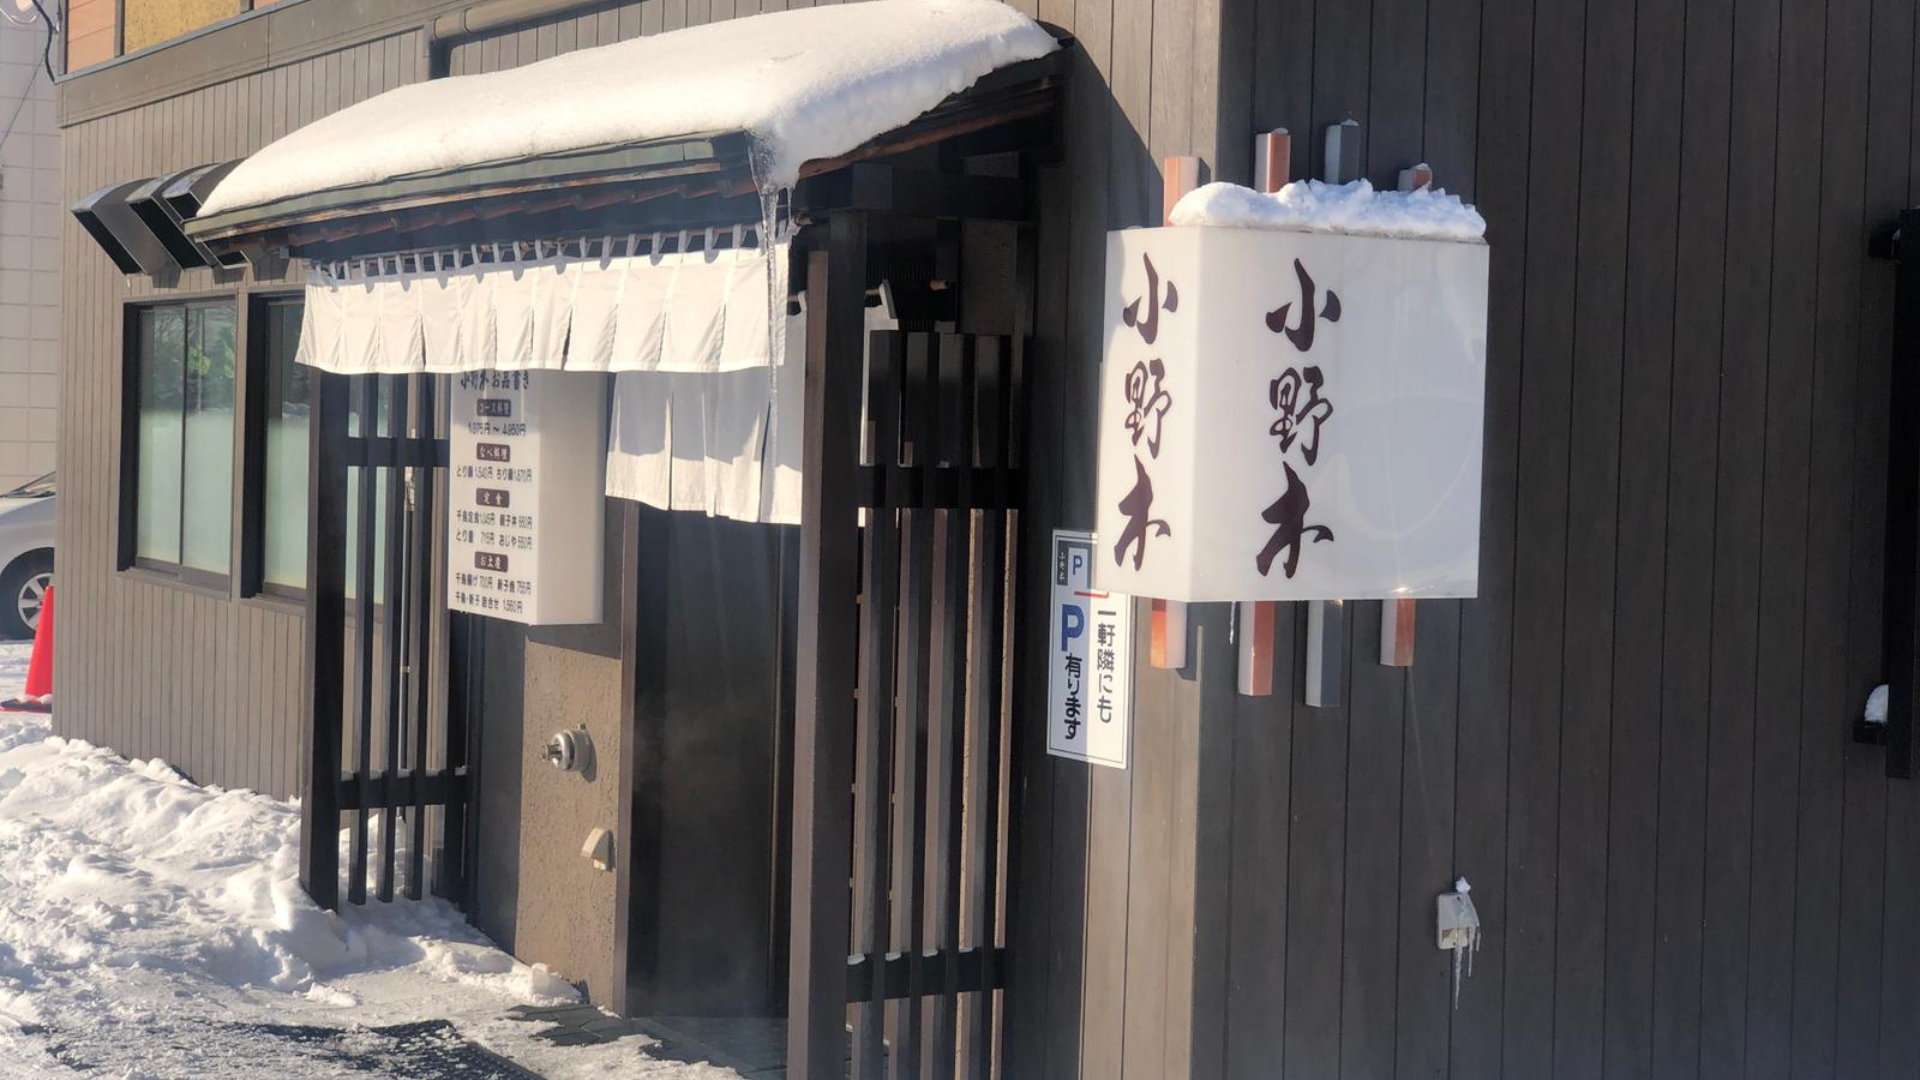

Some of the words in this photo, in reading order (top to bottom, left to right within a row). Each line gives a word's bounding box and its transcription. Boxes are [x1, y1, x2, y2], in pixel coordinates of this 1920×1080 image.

[1114, 252, 1178, 571] 小野木
[1255, 258, 1342, 579] 小野木
[479, 446, 508, 460] なべ料理
[480, 555, 501, 570] お土産
[1073, 554, 1083, 576] P
[1097, 610, 1117, 724] 一軒隣にも
